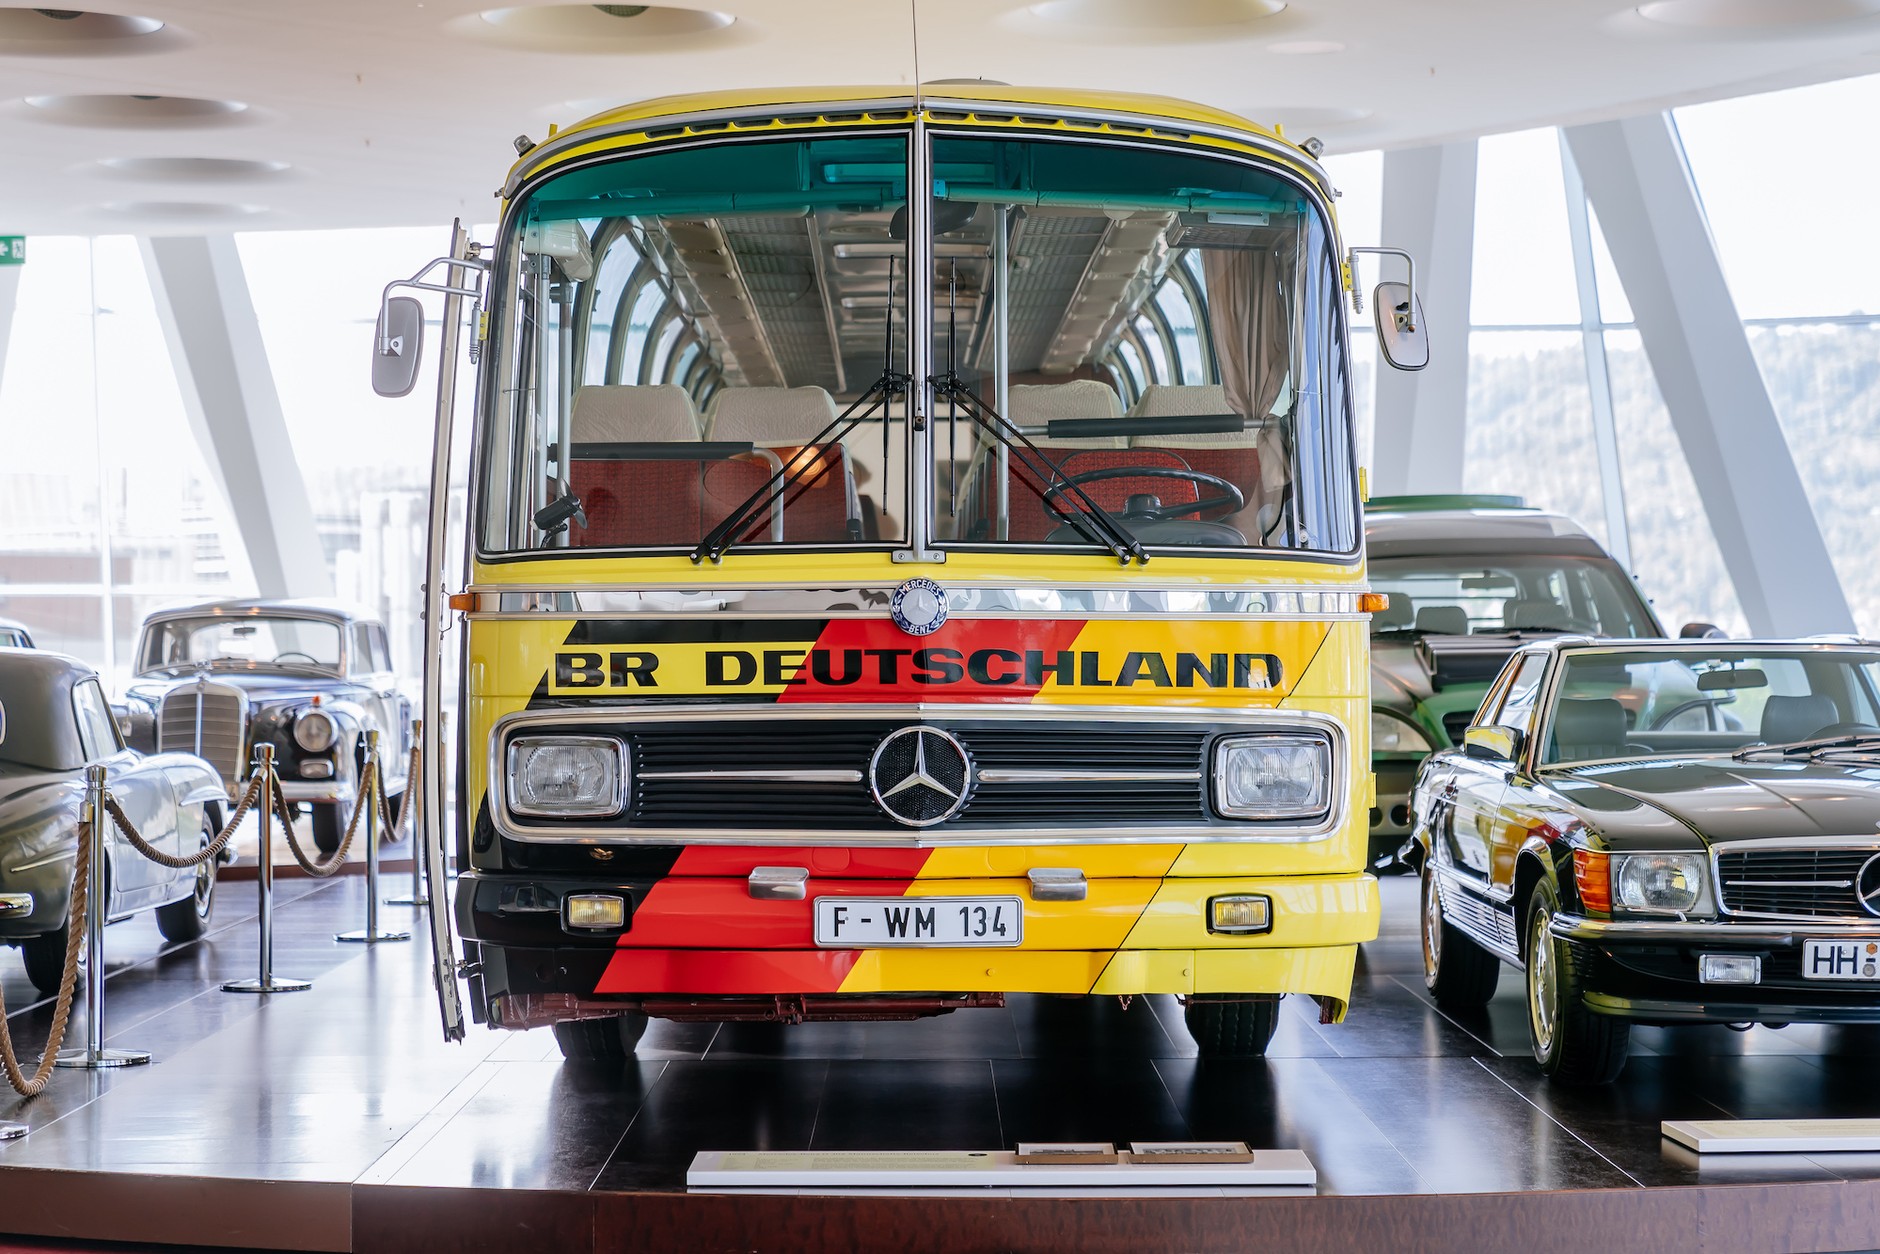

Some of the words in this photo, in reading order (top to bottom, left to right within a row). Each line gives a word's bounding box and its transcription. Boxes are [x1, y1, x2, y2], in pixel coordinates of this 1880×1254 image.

[900, 579, 942, 596] MERCEDES
[908, 624, 932, 634] BENZ
[555, 651, 659, 688] BR
[705, 648, 1284, 689] DEUTSCHLAND
[959, 906, 1007, 937] 134
